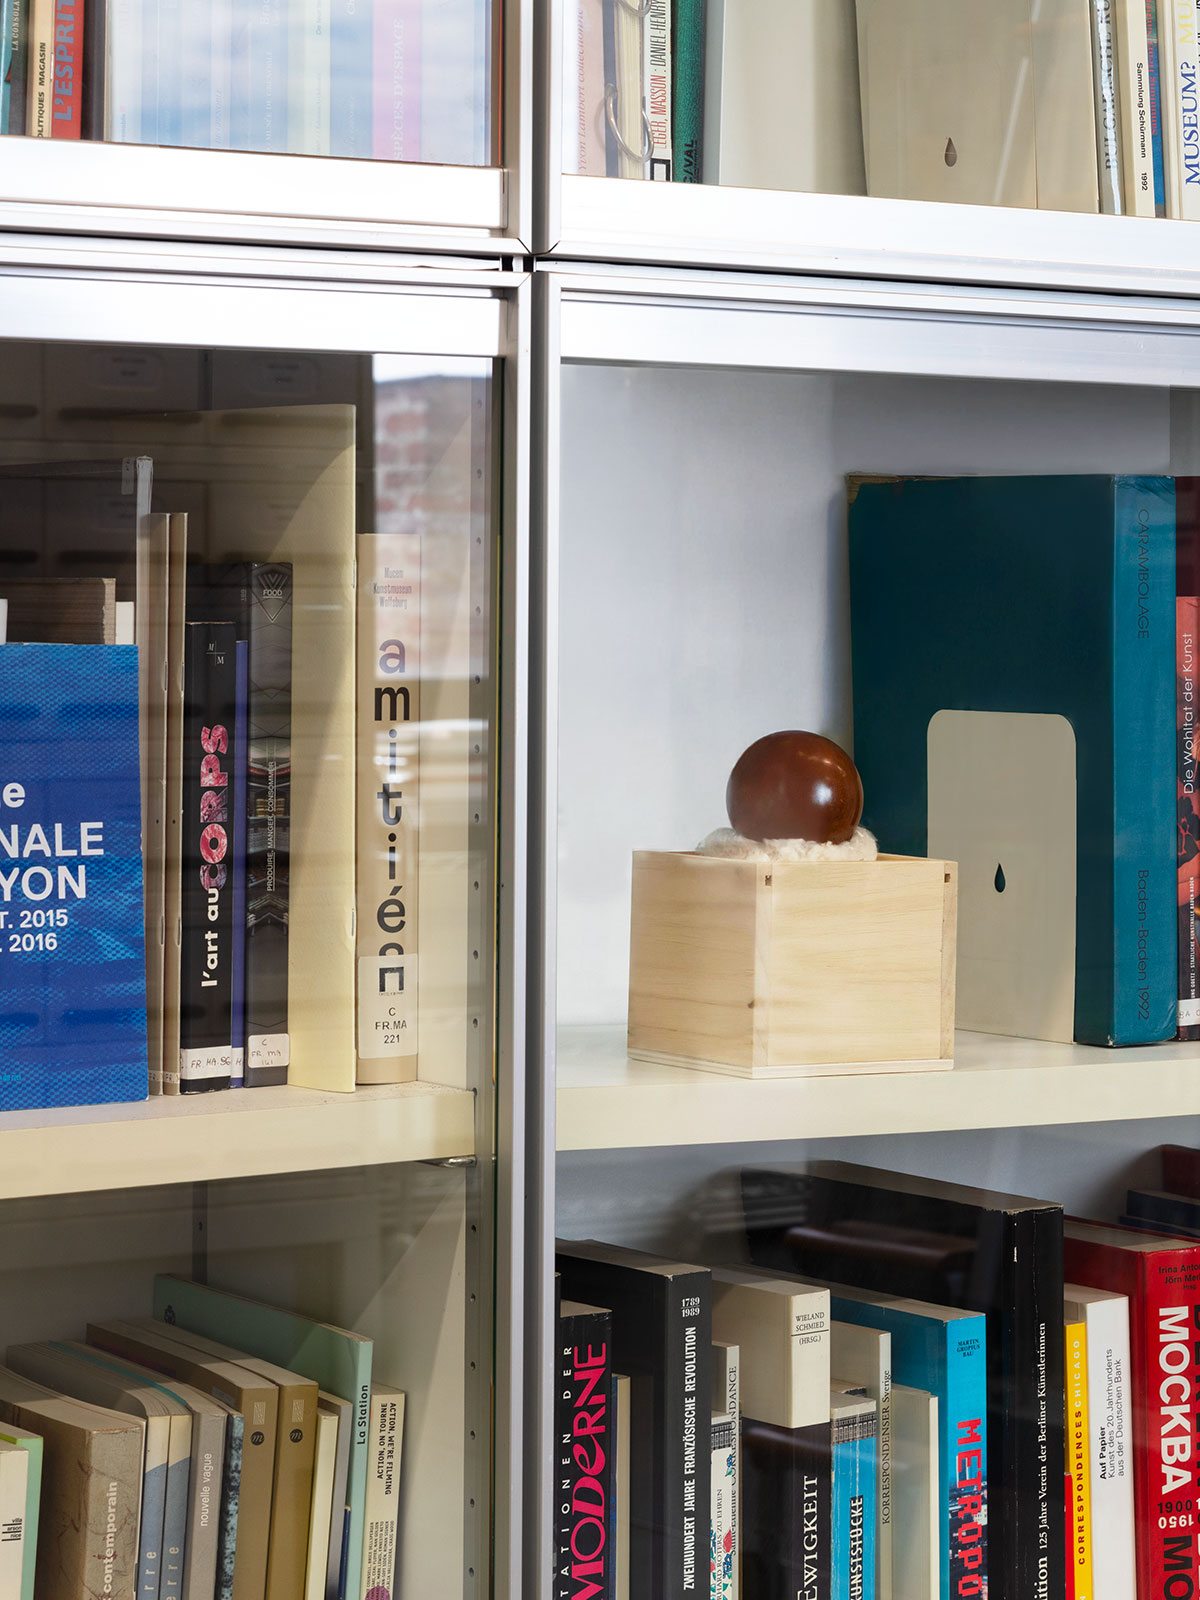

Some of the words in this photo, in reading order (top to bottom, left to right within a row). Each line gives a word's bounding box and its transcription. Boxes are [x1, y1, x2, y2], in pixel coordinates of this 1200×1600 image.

[650, 0, 668, 68] DANIEL-HENRY
[39, 42, 47, 86] MAGASIN
[54, 0, 75, 121] L'ESPRIT
[391, 18, 405, 97] D'ESPACE
[650, 74, 668, 117] MASSON
[1136, 62, 1148, 109] Sammlung
[577, 86, 587, 139] Lambert
[1181, 60, 1200, 186] MUSEUM?
[1141, 172, 1150, 192] 1992
[1136, 509, 1152, 640] CARAMBOLAGE
[1182, 704, 1195, 766] Wohltat
[199, 720, 228, 892] CORPS
[20, 908, 69, 929] 2015
[1136, 869, 1151, 982] Baden-Baden
[9, 932, 59, 954] 2016
[200, 930, 219, 986] l'art
[374, 1019, 408, 1031] FR.MA
[388, 1007, 396, 1017] C
[1136, 984, 1151, 1021] 1992
[383, 1034, 401, 1045] 221
[681, 1296, 701, 1308] 1789
[795, 1311, 825, 1323] WIELAND
[795, 1320, 825, 1332] SCHMIED
[562, 1347, 573, 1401] DER
[684, 1326, 698, 1392] REVOLUTION
[1037, 1322, 1047, 1399] Künstlerinnen
[1073, 1340, 1083, 1408] CHICAGO
[1104, 1348, 1114, 1411] Jahrhunderts
[356, 1384, 369, 1430] Station
[379, 1402, 388, 1434] TOURNE
[1037, 1400, 1047, 1443] Berliner
[1114, 1385, 1124, 1439] Deutschen
[356, 1431, 367, 1446] La
[681, 1396, 697, 1475] FRANZÖSISCHE
[1098, 1425, 1108, 1460] Papier
[201, 1453, 214, 1484] vague
[881, 1405, 892, 1526] KORRESPONDENSER
[1037, 1465, 1048, 1500] Verein
[1074, 1410, 1086, 1566] CORRESPONDENCES
[198, 1485, 211, 1528] nouvelle
[683, 1478, 697, 1512] JAHRE
[1038, 1501, 1050, 1529] Jahre
[1157, 1499, 1193, 1515] 1900
[103, 1481, 118, 1594] contemporain
[1157, 1513, 1195, 1529] 1950
[683, 1516, 697, 1591] ZWEIHUNDERT
